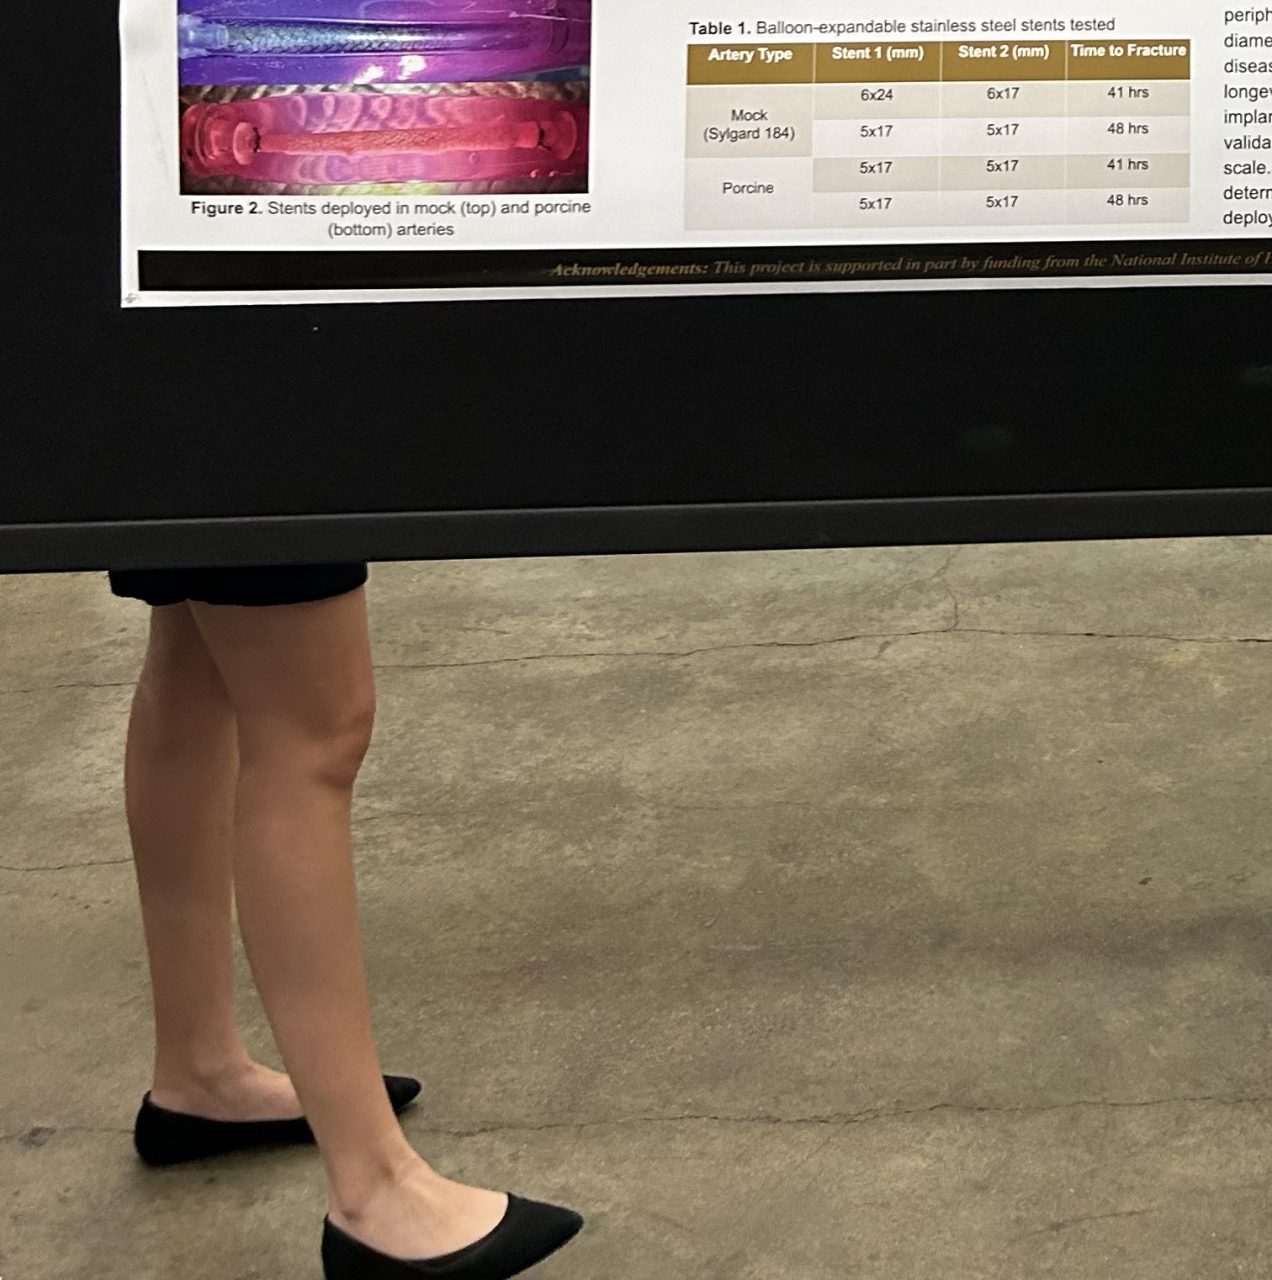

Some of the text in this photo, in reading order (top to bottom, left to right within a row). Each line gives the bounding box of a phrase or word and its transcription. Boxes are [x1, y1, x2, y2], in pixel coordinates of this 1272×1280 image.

[689, 18, 1115, 36] Table 1. Balloon-expandable stainless steel stents tested
[708, 48, 792, 63] Artery Type
[832, 46, 924, 61] Stent 1 (mm)
[959, 45, 1050, 60] Stent 2 (mm)
[1071, 44, 1186, 56] Time to Fracture
[861, 89, 893, 101] 6x24
[987, 87, 1020, 99] 6x17
[1108, 86, 1149, 98] 41 hrs
[731, 109, 768, 121] Mock
[704, 127, 795, 143] (Sylgard 184)
[723, 182, 774, 194] Porcine
[192, 201, 591, 218] Figure 2. Stents deployed in mock (top) and porcine
[550, 262, 709, 278] Acknowledgements:
[714, 261, 746, 274] This
[749, 260, 805, 277] project
[809, 260, 823, 273] is
[826, 258, 902, 275] supported
[906, 258, 921, 271] in
[923, 259, 957, 275] part
[961, 257, 980, 273] by
[982, 256, 1039, 272] funding
[1042, 255, 1080, 271] from
[1084, 254, 1108, 267] the
[1111, 253, 1175, 267] National
[1180, 253, 1241, 266] Institute
[1244, 252, 1263, 268] of
